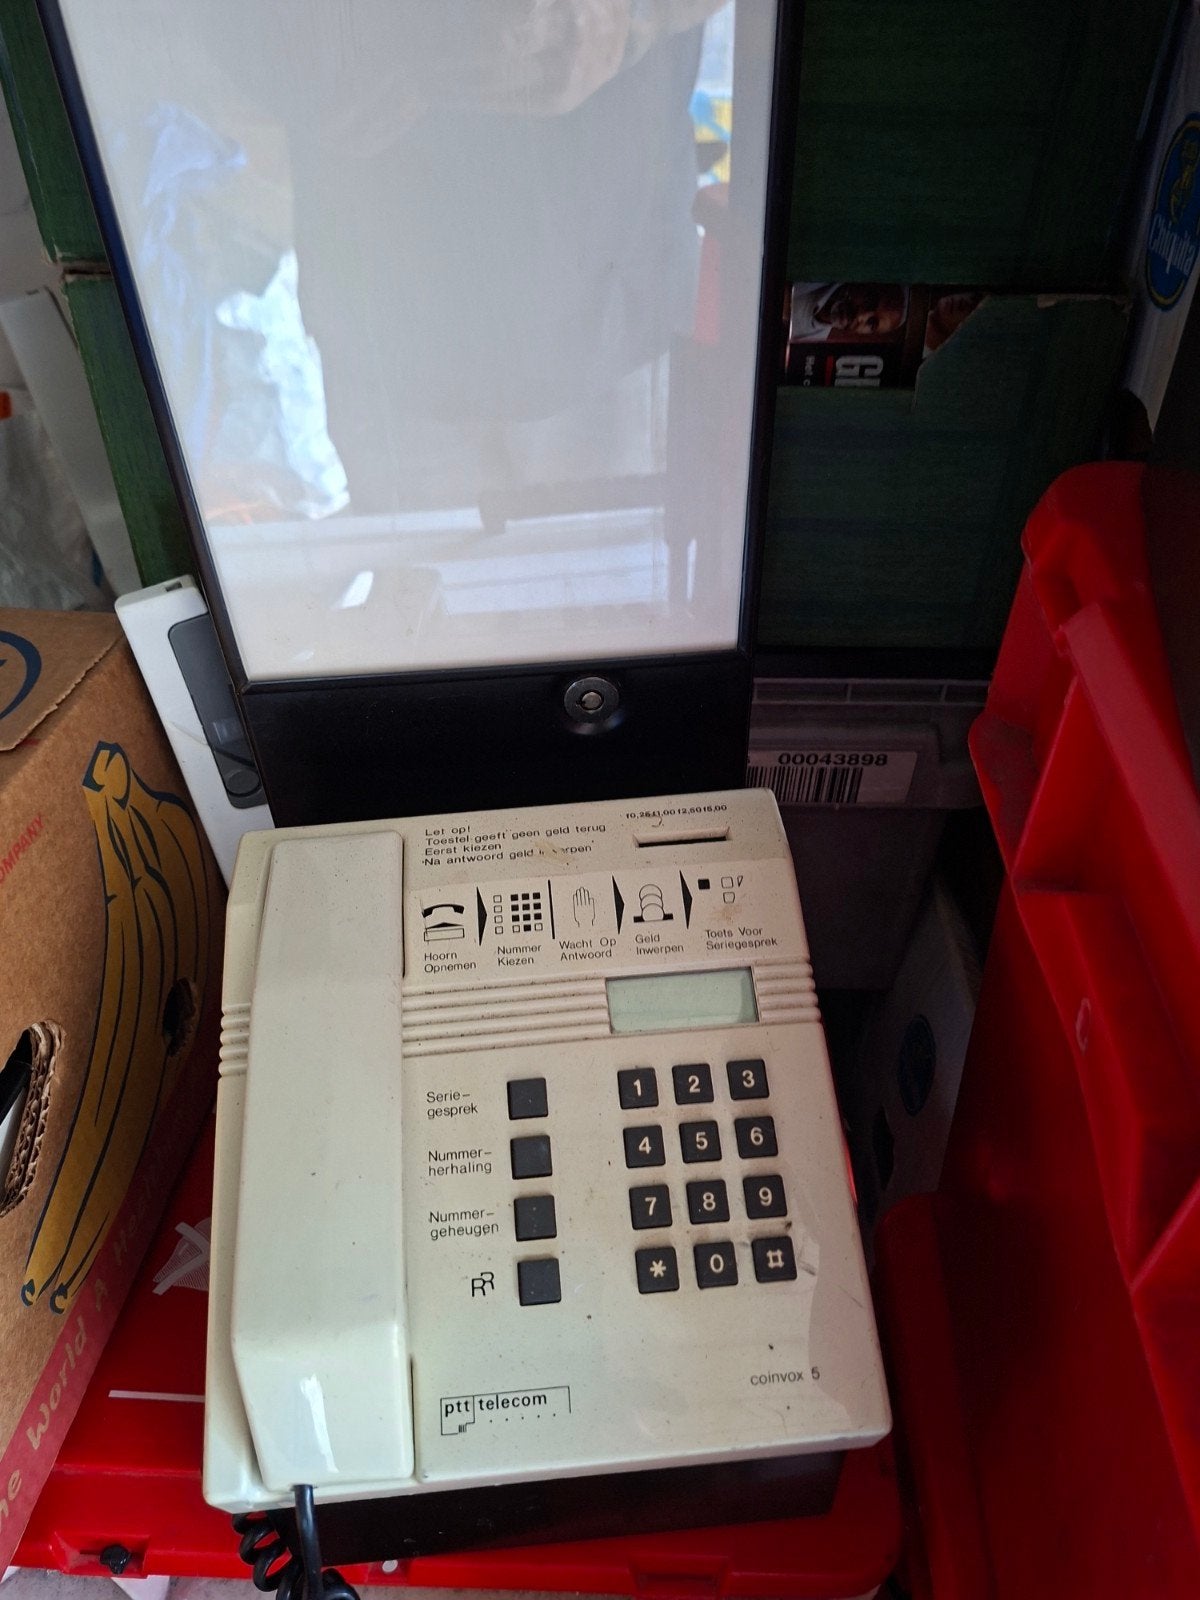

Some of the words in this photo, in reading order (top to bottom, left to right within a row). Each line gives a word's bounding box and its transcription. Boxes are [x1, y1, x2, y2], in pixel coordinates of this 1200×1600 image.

[777, 752, 888, 766] 00043898
[425, 828, 445, 837] Let
[451, 825, 471, 836] op!
[426, 835, 470, 847] Toestel
[475, 832, 506, 844] geeft
[512, 830, 540, 840] geen
[545, 826, 570, 837] geld
[576, 823, 606, 833] terug
[425, 847, 457, 856] Eerst
[463, 843, 502, 853] kiezen
[424, 857, 441, 867] Na
[447, 852, 504, 865] antwoord
[509, 849, 534, 860] geld
[635, 934, 660, 944] Geld
[706, 929, 733, 939] Toets
[738, 926, 763, 937] Voor
[497, 944, 541, 955] Nummer
[559, 939, 593, 950] Wacht
[600, 936, 617, 949] Op
[636, 944, 684, 956] Inwerpen
[706, 937, 778, 951] Seriegesprek
[424, 951, 458, 962] Hoorn
[497, 955, 534, 967] Kiezen
[560, 949, 612, 961] Antwoord
[424, 961, 477, 974] Opnemen
[633, 1078, 642, 1097] 1
[688, 1075, 701, 1093] 2
[742, 1069, 755, 1088] 3
[426, 1089, 471, 1103] Serie-
[427, 1102, 478, 1120] gesprek
[638, 1136, 652, 1154] 4
[695, 1131, 708, 1150] 5
[750, 1126, 764, 1146] 6
[428, 1148, 492, 1162] Nummer-
[428, 1160, 493, 1176] herhaling
[644, 1196, 657, 1216] 7
[702, 1192, 716, 1212] 8
[758, 1187, 773, 1207] 9
[429, 1208, 495, 1223] Nummer-
[430, 1222, 499, 1241] geheugen
[709, 1253, 724, 1274] 0
[26, 1315, 87, 1451] World
[750, 1370, 804, 1386] coinvox
[444, 1400, 470, 1418] ptt
[478, 1394, 547, 1411] telecom
